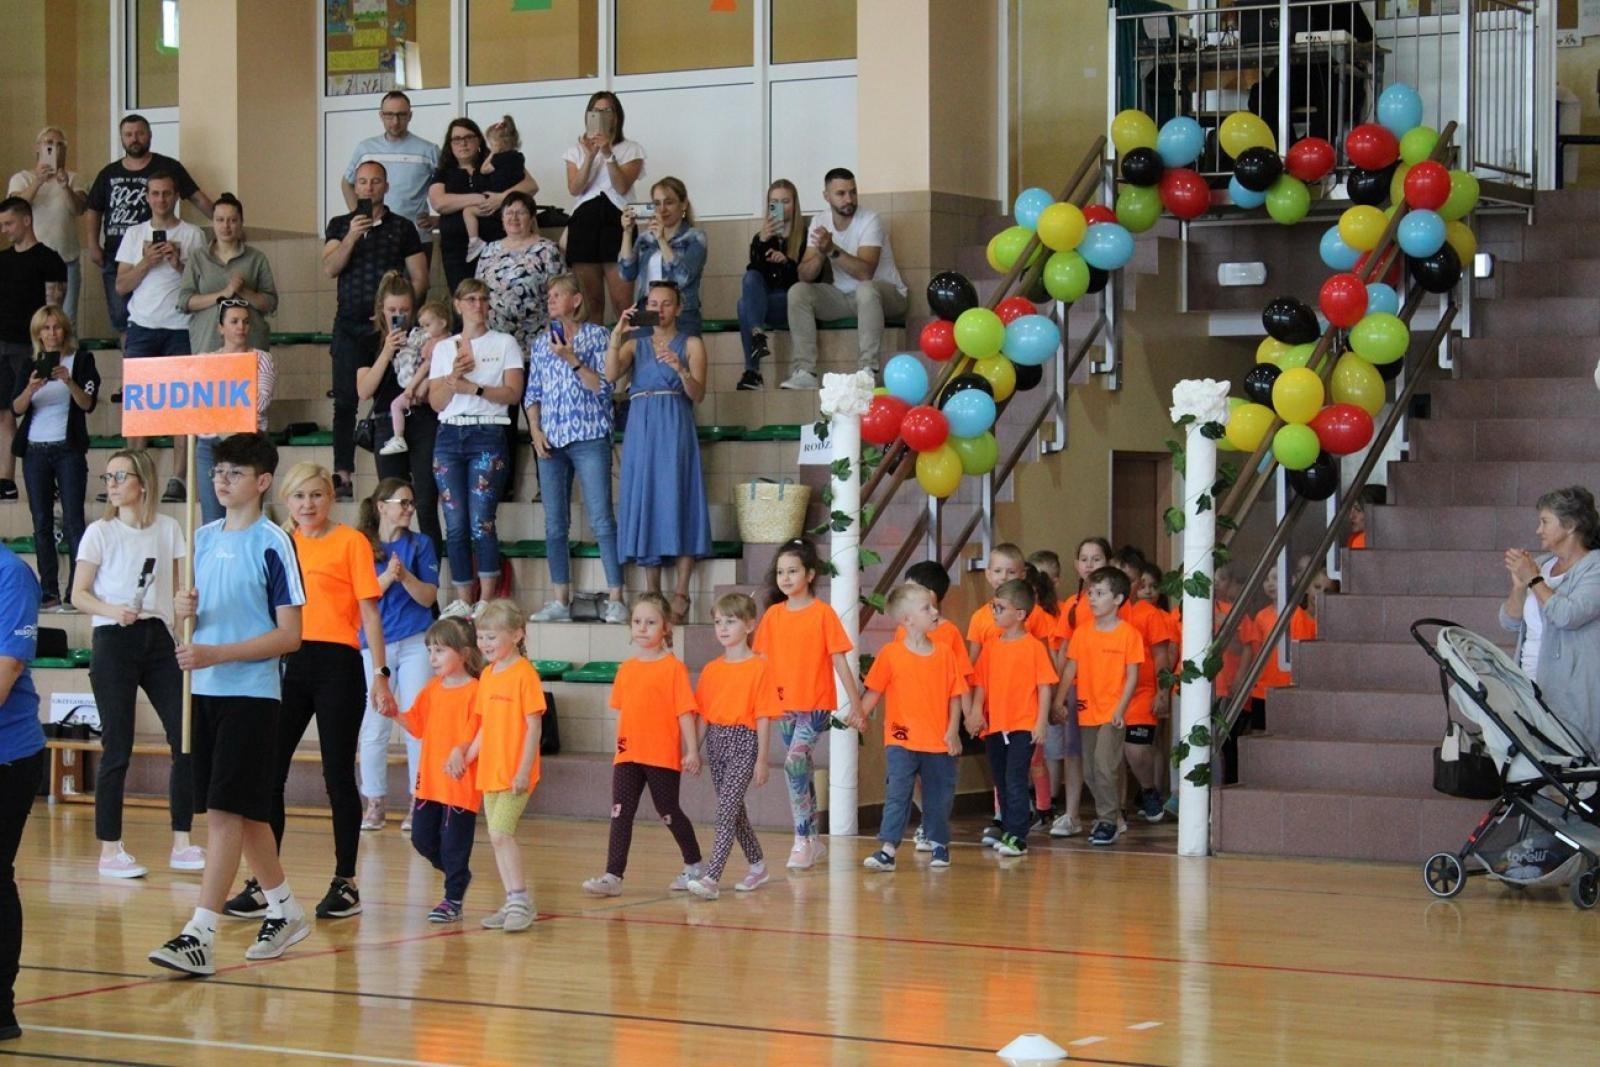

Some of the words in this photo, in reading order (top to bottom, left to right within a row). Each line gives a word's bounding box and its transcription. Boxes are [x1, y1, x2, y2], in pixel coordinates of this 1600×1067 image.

[110, 185, 147, 208] ROCK
[124, 380, 251, 411] RUDNIK
[804, 440, 833, 452] RODZ
